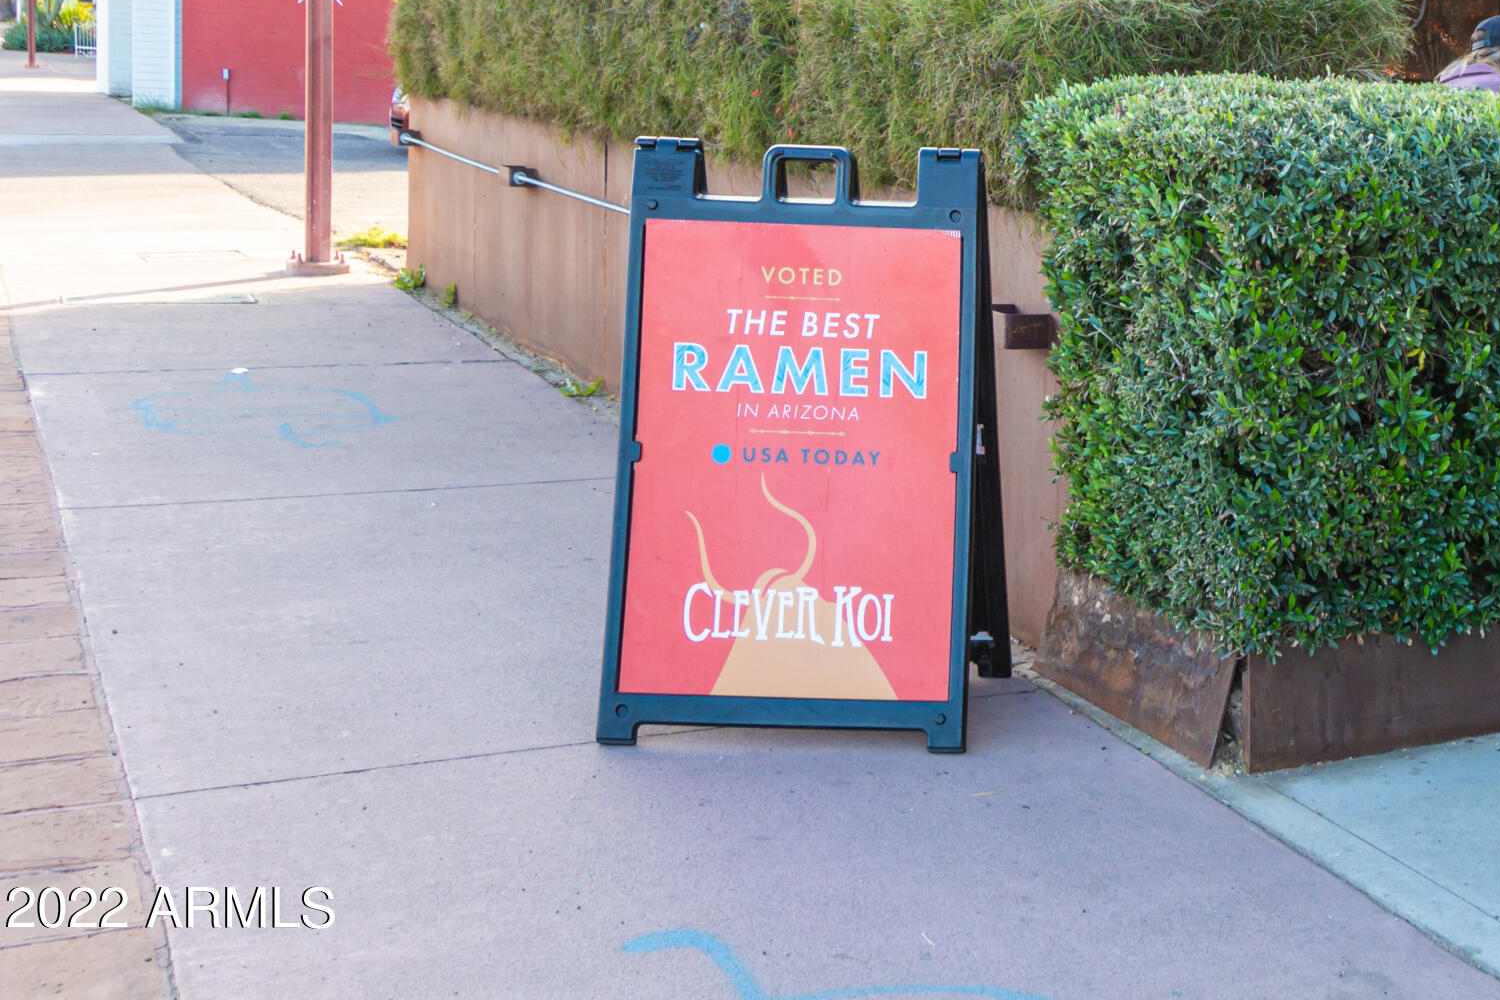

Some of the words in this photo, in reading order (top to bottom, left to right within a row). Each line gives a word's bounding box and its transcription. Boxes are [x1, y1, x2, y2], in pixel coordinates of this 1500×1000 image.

[761, 266, 843, 286] VOTED
[726, 309, 787, 337] THE
[801, 311, 880, 339] BEST
[671, 342, 928, 399] RAMEN
[736, 403, 758, 417] IN
[766, 404, 860, 421] ARIZONA
[743, 447, 789, 464] USA
[801, 449, 881, 467] TODAY
[683, 582, 825, 645] CLEVER
[833, 586, 894, 648] KOI
